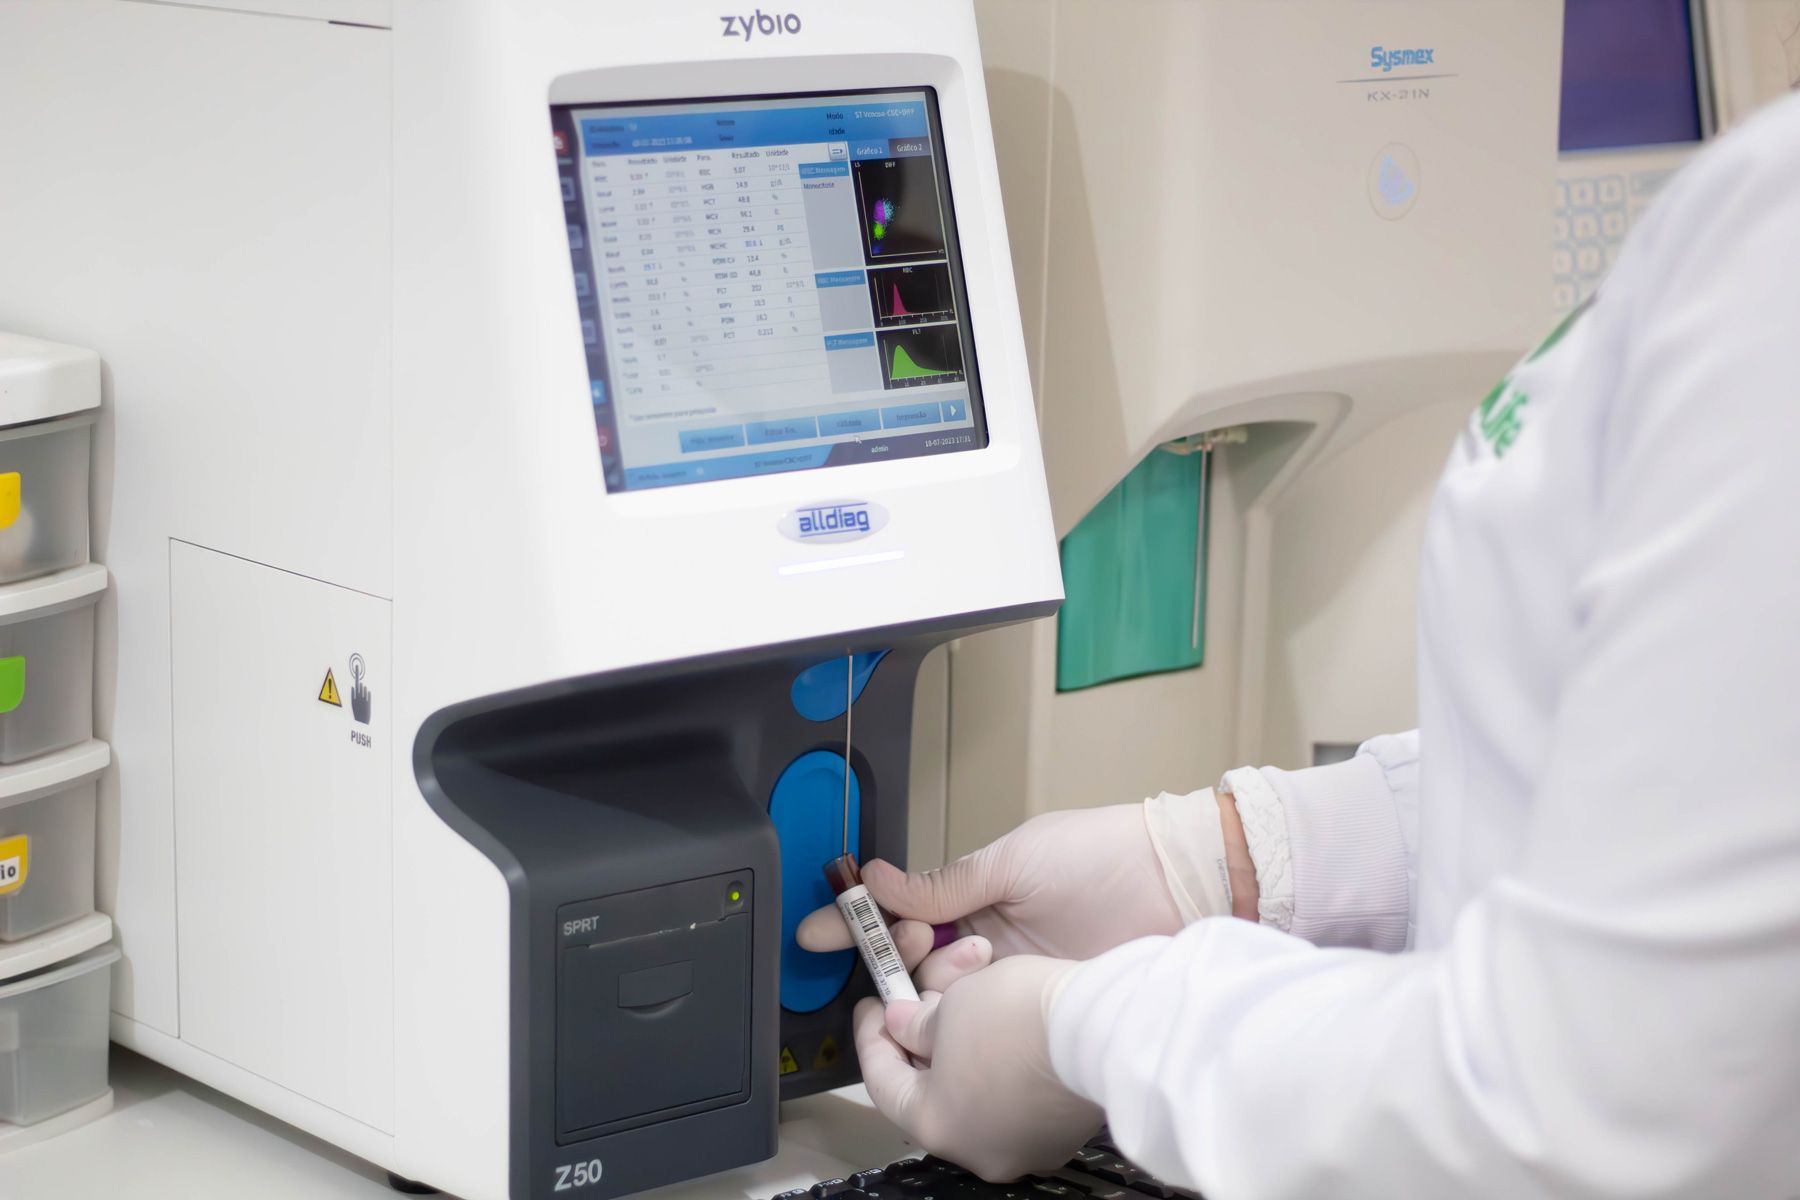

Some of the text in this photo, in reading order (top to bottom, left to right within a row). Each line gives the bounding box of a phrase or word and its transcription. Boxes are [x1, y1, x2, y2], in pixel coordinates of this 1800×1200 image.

[720, 8, 802, 42] zybio
[1370, 46, 1434, 72] Sysmex
[1367, 88, 1430, 102] KX-21N
[799, 506, 870, 532] alldiag
[350, 730, 372, 749] PUSH
[563, 915, 600, 936] SPRT
[554, 1158, 603, 1192] Z50
